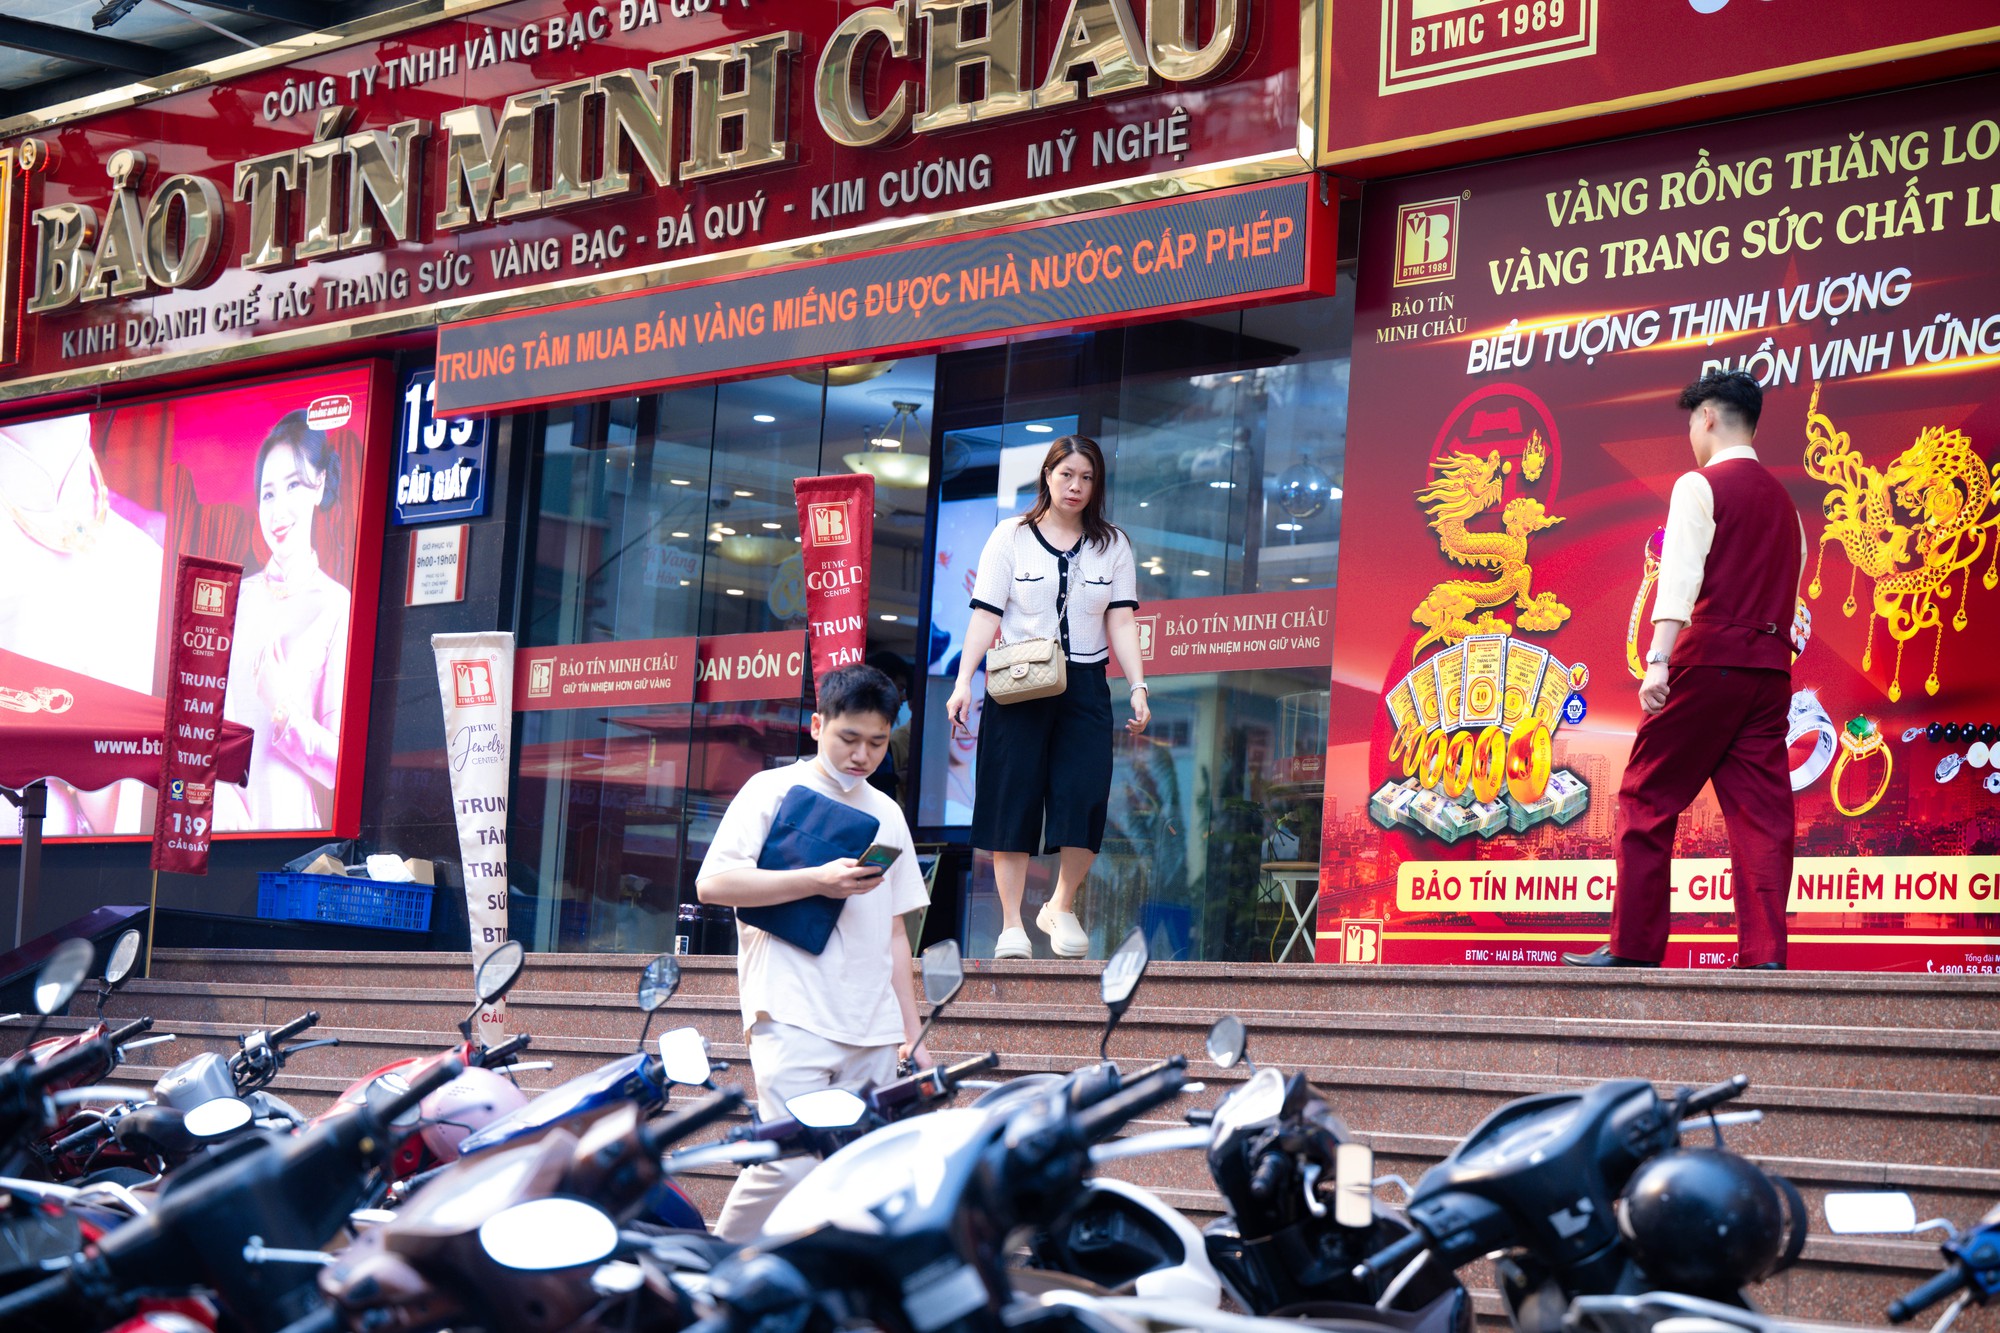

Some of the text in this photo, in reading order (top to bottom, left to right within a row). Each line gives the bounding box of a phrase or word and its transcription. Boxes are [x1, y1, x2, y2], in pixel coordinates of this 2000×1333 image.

[1410, 0, 1565, 57] BTMC 1989
[262, 76, 336, 121] CÔNG
[347, 64, 380, 100] TY
[384, 44, 457, 89] TNHH
[464, 24, 540, 70] VÀNG
[547, 8, 607, 51] BẠC
[27, 148, 228, 314] BẢO
[233, 105, 432, 272] TÍN
[436, 30, 801, 231] MINH
[1546, 119, 2000, 228] VÀNG RỒNG THĂNG LO
[62, 317, 116, 359] KINH
[125, 305, 206, 347] DOANH
[212, 287, 260, 332] CHẾ
[269, 280, 314, 318] TÁC
[323, 266, 411, 311] TRANG
[418, 248, 473, 292] SỨC
[490, 234, 561, 280] VÀNG
[571, 224, 628, 268] BẠC
[657, 206, 697, 250] ĐÁ
[703, 189, 767, 240] QUÝ
[811, 177, 867, 221] KIM
[878, 153, 993, 209] CƯƠNG
[1027, 127, 1079, 180] MỸ
[1091, 105, 1192, 168] NGHỆ
[1488, 246, 1589, 296] VÀNG
[1600, 225, 1730, 279] TRANG
[1741, 206, 1824, 259] SỨC
[1836, 175, 1954, 244] CHẤT
[1402, 262, 1448, 277] BTMC 1989
[440, 210, 1296, 384] TRUNG TÂM MUA BÁN VÀNG MIẾNG ĐƯỢC NHÀ NƯỚC CẤP PHÉP
[1391, 292, 1455, 318] BẢO TÍN
[1375, 315, 1468, 344] MINH CHÂU
[1466, 266, 1913, 375] BIỂU TƯỢNG THỊNH VƯỢNG
[1809, 330, 1900, 381] VINH
[1902, 312, 2000, 367] VỮNG
[821, 559, 848, 570] BTMC
[807, 565, 863, 590] GOLD
[824, 588, 850, 598] CENTER
[195, 625, 218, 635] BTMC
[813, 615, 863, 637] TRUN
[1165, 606, 1329, 636] BẢO TÍN MINH CHÂU
[183, 631, 230, 652] GOLD
[1170, 636, 1320, 657] GIỮ TÍN NHIỆM HƠN GIỮ VÀNG
[559, 652, 678, 677] BẢO TÍN MINH CHÂU
[737, 649, 781, 679] ĐÓN
[787, 651, 805, 676] C
[180, 671, 226, 690] TRUNG
[578, 680, 589, 693] TÍN
[591, 681, 614, 694] NHIỆM
[615, 679, 632, 691] HƠN
[649, 676, 671, 689] VÀNG
[184, 698, 214, 714] TÂM
[179, 724, 215, 741] VÀNG
[470, 723, 497, 733] BTMC
[177, 750, 213, 767] BTMC
[452, 726, 505, 772] Jewelry
[472, 756, 498, 765] CENTER
[172, 813, 208, 837] 139
[1411, 869, 1462, 901] BẢO
[1469, 870, 1507, 901] TÍN
[1515, 876, 1578, 901] MINH
[1797, 867, 1883, 908] NHIỆM
[1894, 871, 1957, 901] HƠN
[1465, 948, 1557, 962] BTMC HAI BÀ TRƯNG
[1699, 953, 1725, 964] BTMC
[1965, 953, 1994, 963] Tổng đài
[1940, 965, 1993, 974] 1800 58 58
